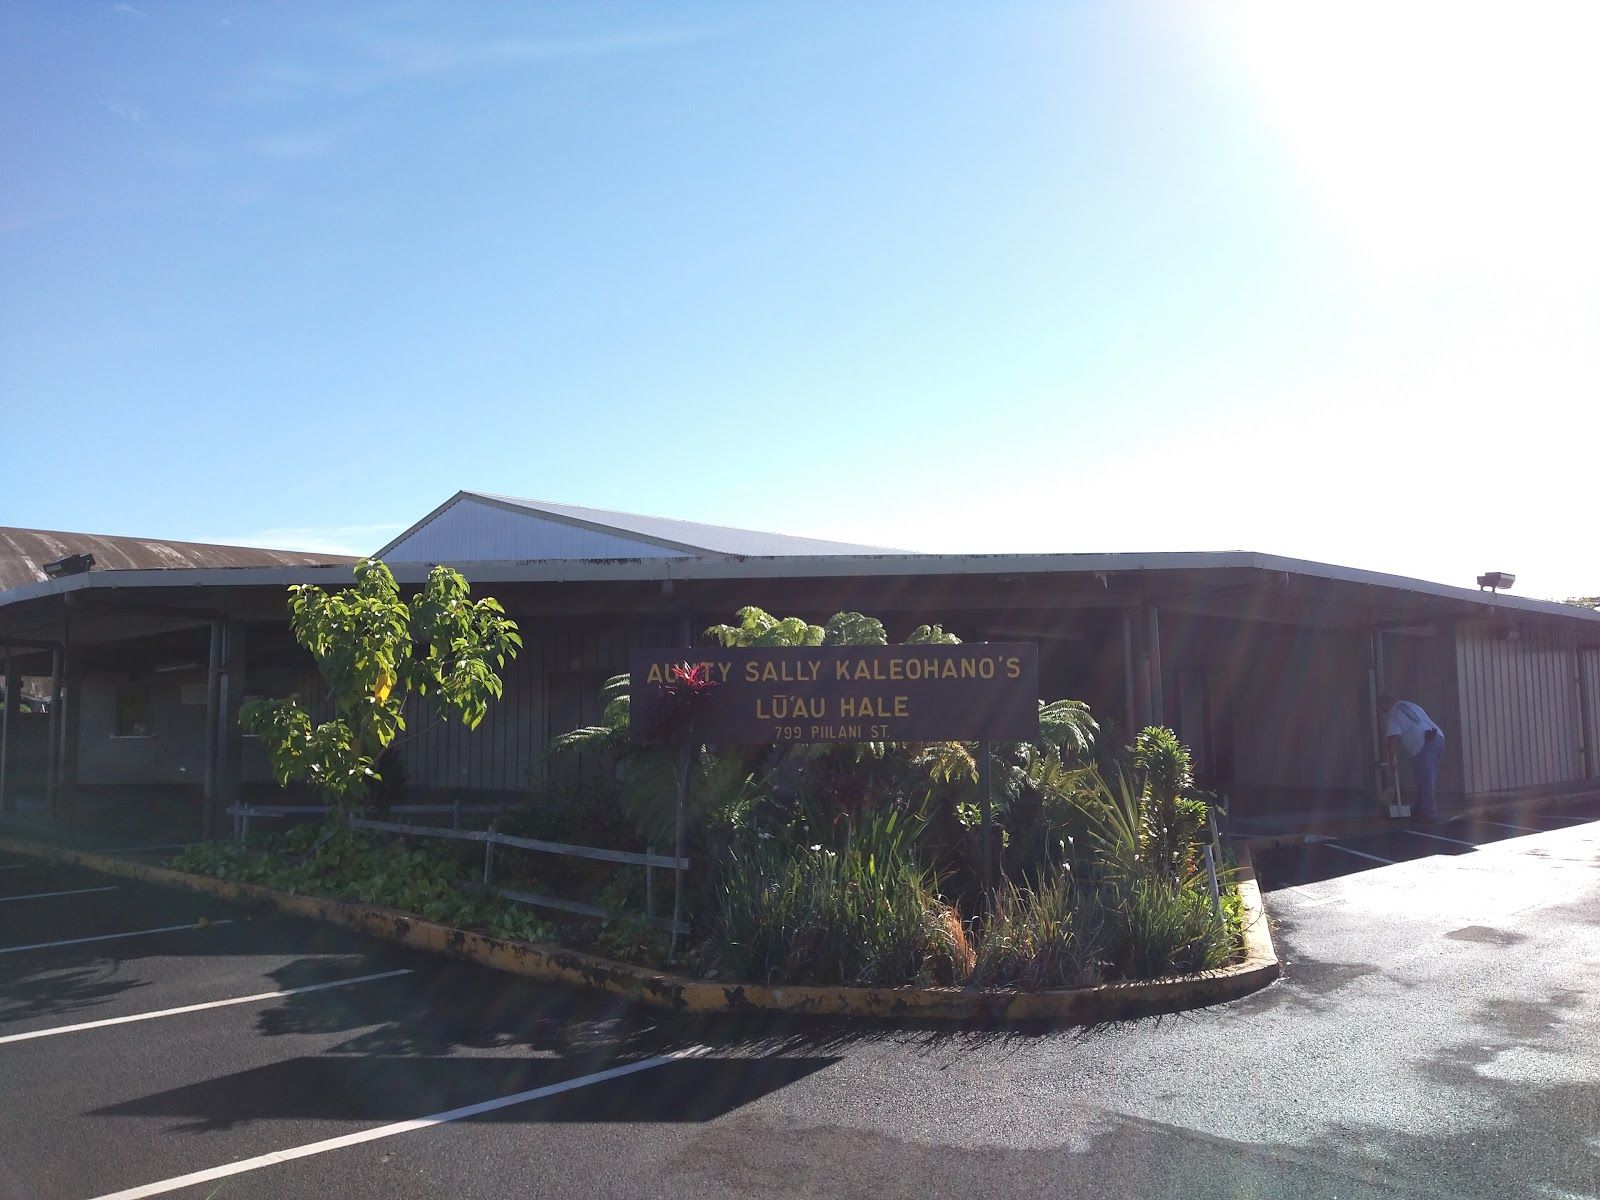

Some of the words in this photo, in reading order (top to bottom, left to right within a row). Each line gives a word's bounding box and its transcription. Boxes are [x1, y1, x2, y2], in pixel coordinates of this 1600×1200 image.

[646, 661, 732, 684] AUTY
[745, 660, 821, 682] SALLY
[836, 656, 1021, 680] KALEOHANO'S
[840, 696, 909, 717] HALE
[775, 726, 802, 739] 799
[811, 725, 861, 739] PIILANI
[870, 724, 890, 738] ST.
